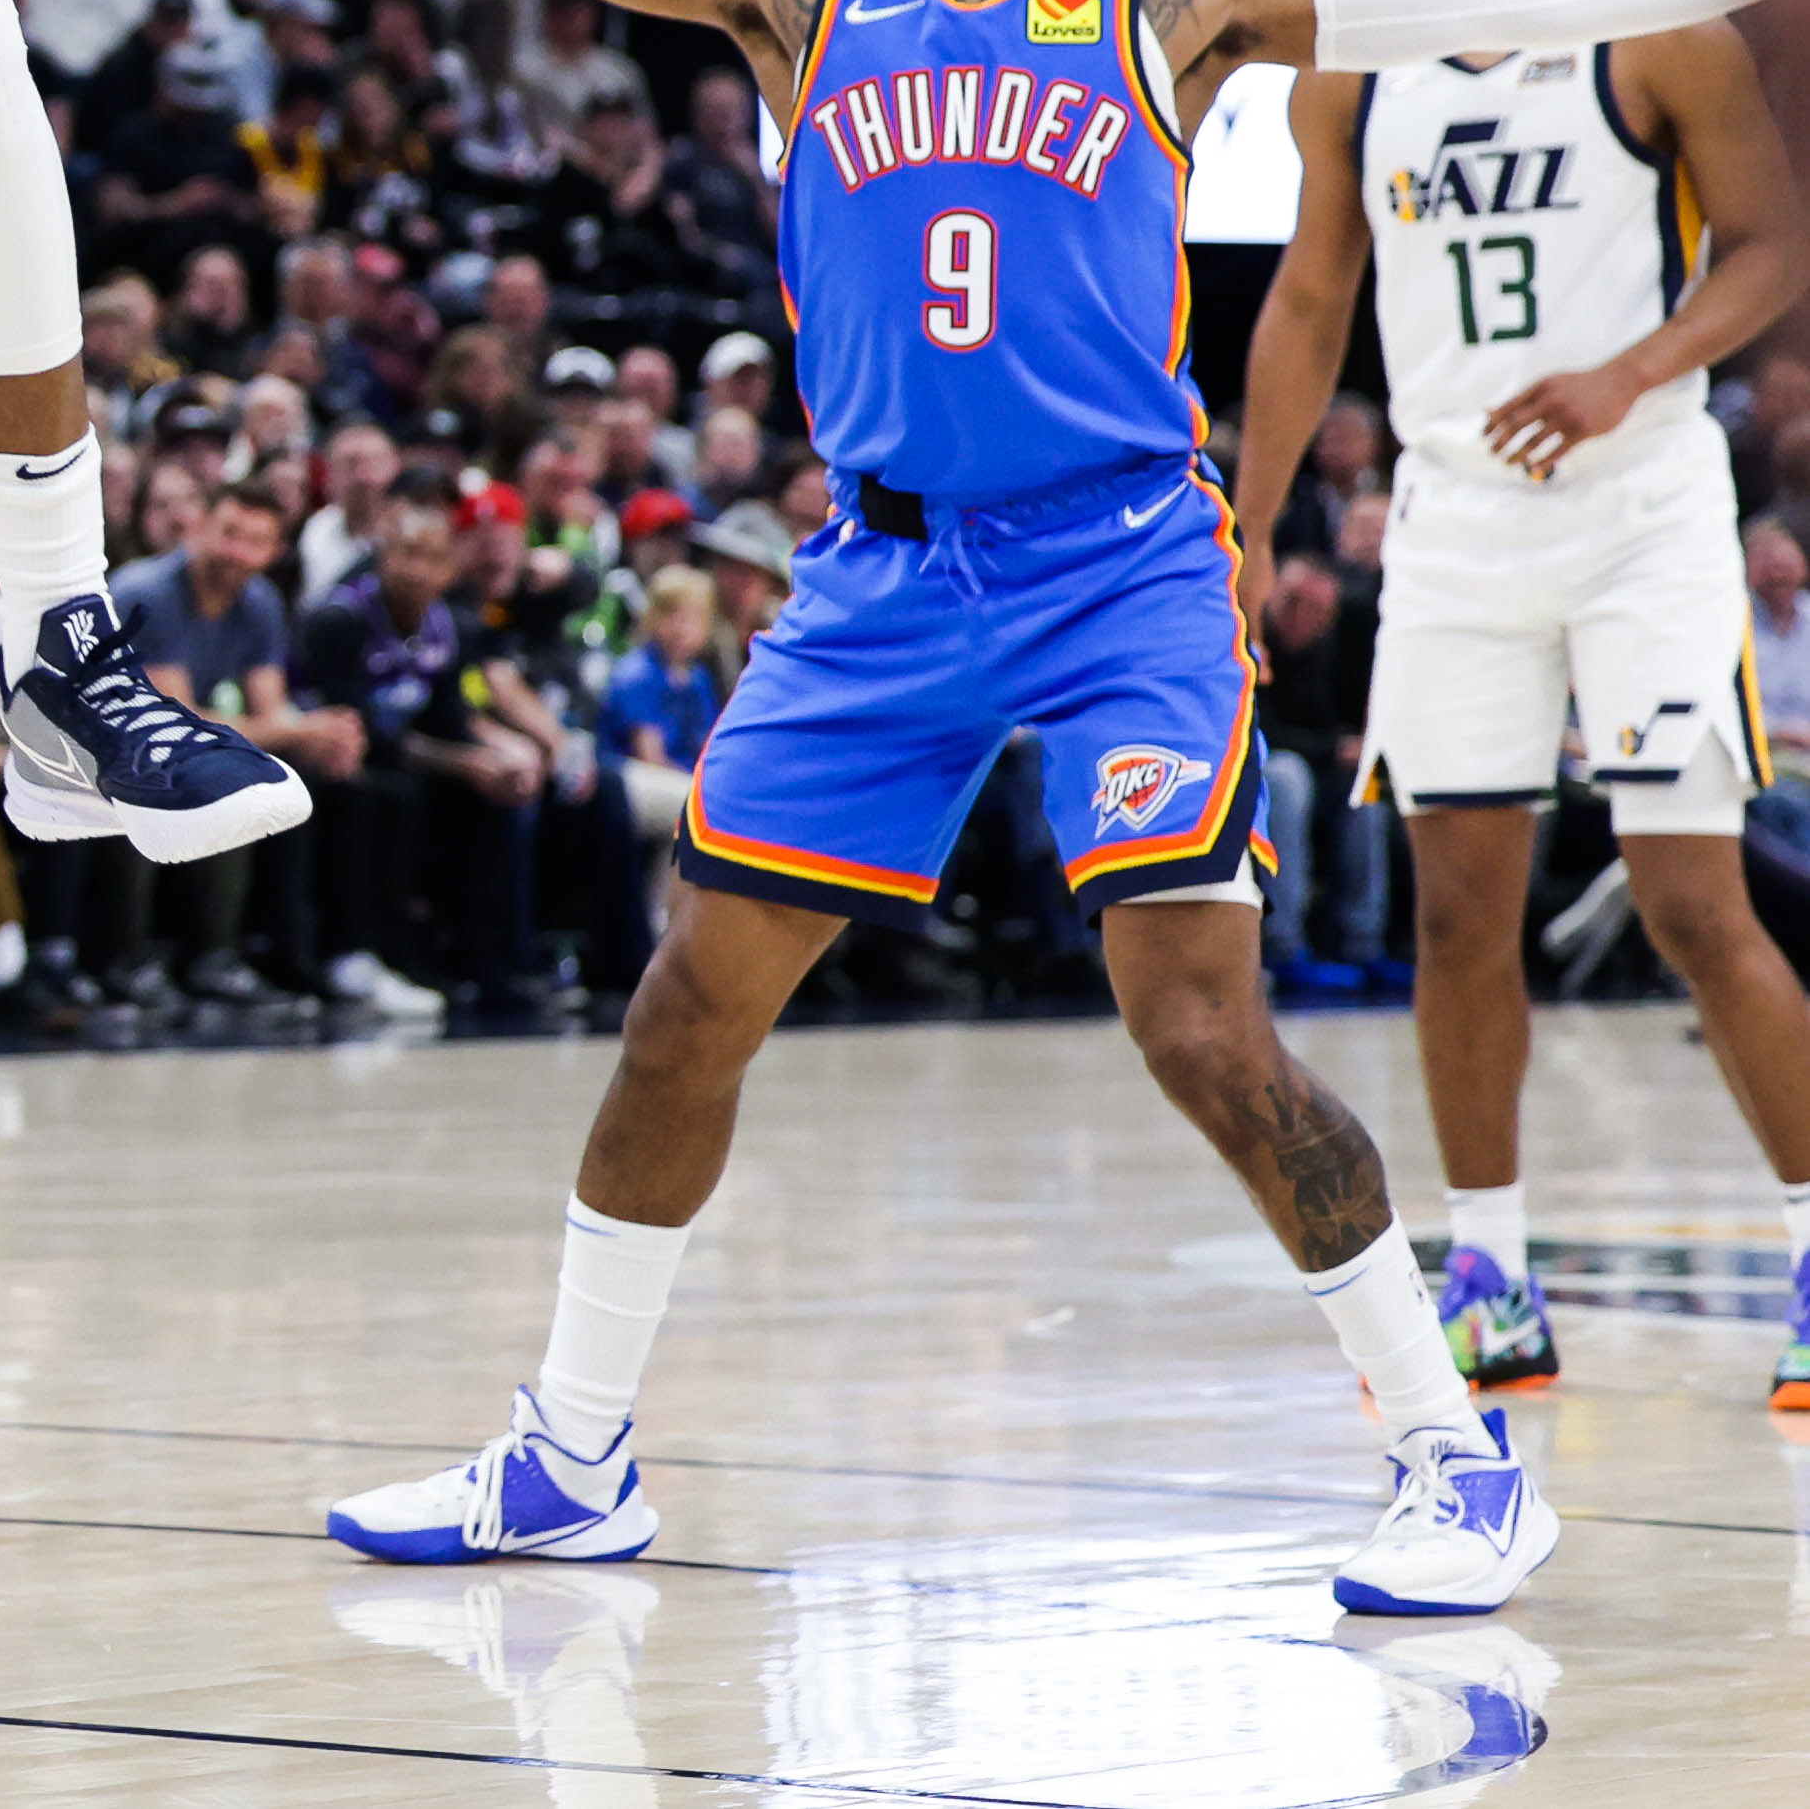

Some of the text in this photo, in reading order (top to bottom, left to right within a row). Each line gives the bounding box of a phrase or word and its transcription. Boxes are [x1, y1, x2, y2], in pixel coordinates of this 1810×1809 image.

[811, 66, 1131, 200] THUNDER
[923, 208, 997, 352] 9
[1446, 235, 1538, 347] 13
[1103, 759, 1161, 815] OKC
